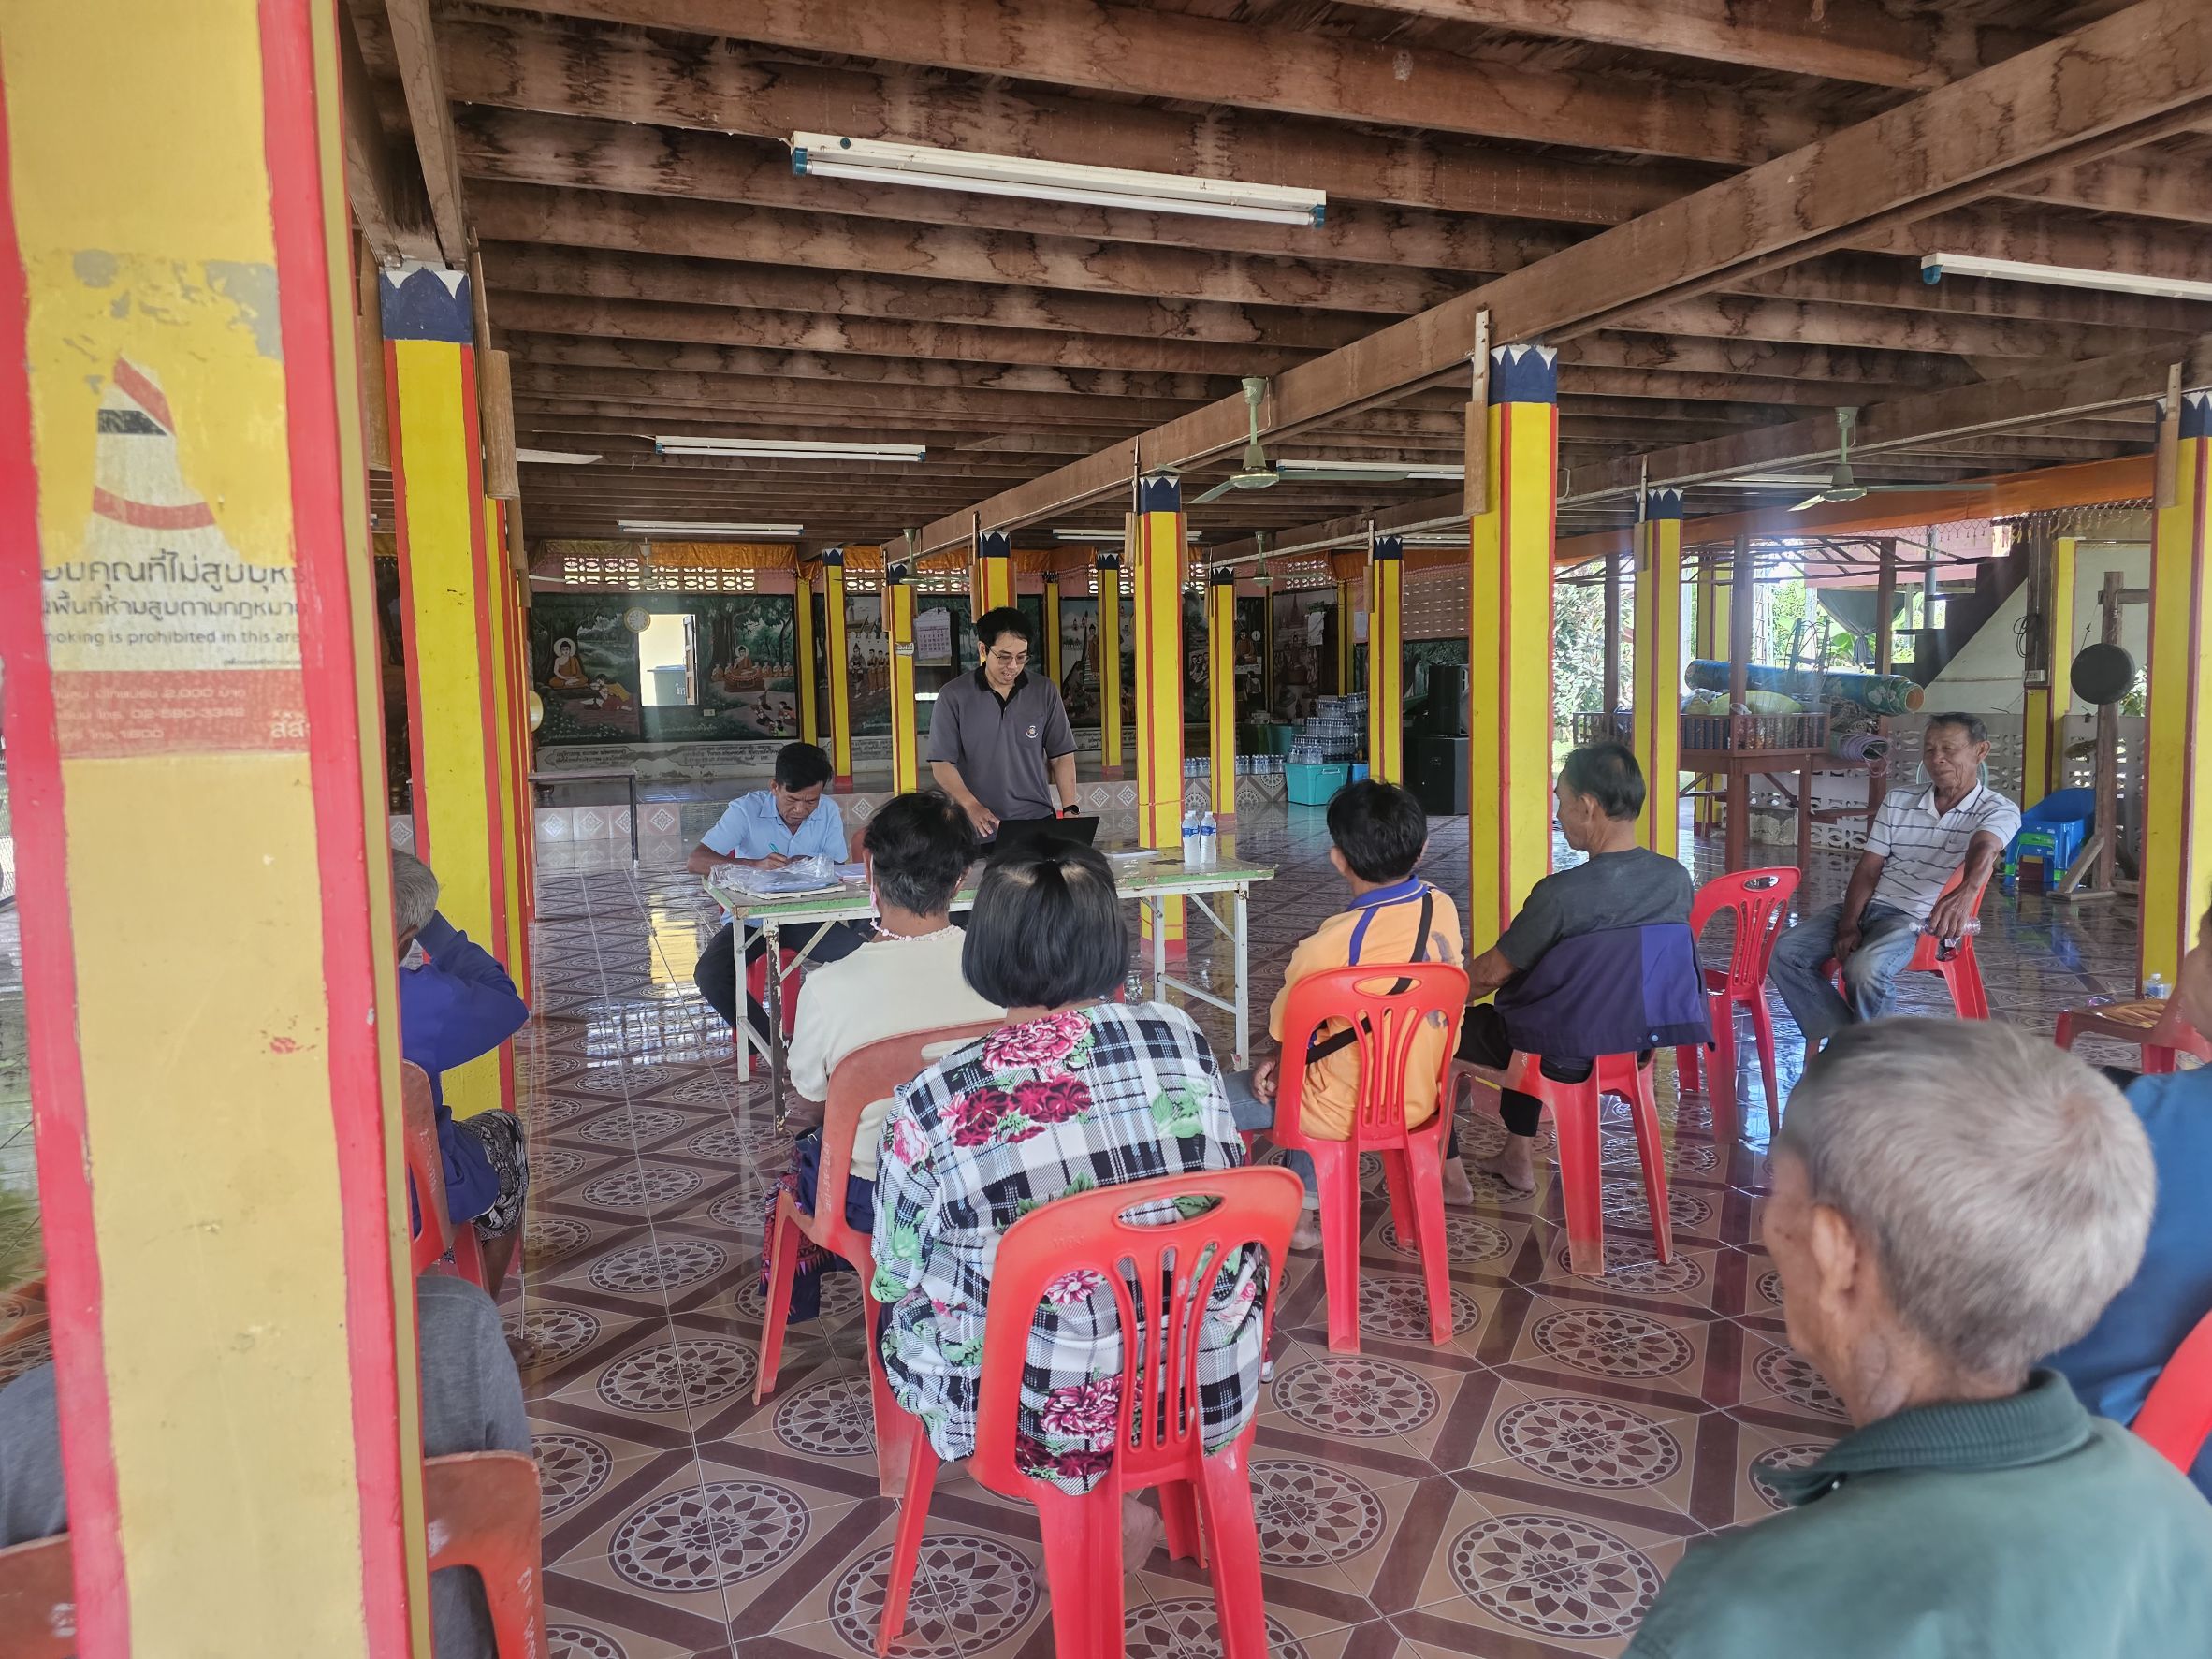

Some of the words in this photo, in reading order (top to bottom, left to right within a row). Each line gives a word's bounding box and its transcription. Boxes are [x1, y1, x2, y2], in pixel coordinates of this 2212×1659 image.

[110, 632, 123, 643] is
[128, 630, 216, 646] prohibited
[221, 633, 237, 643] in
[241, 631, 270, 643] this
